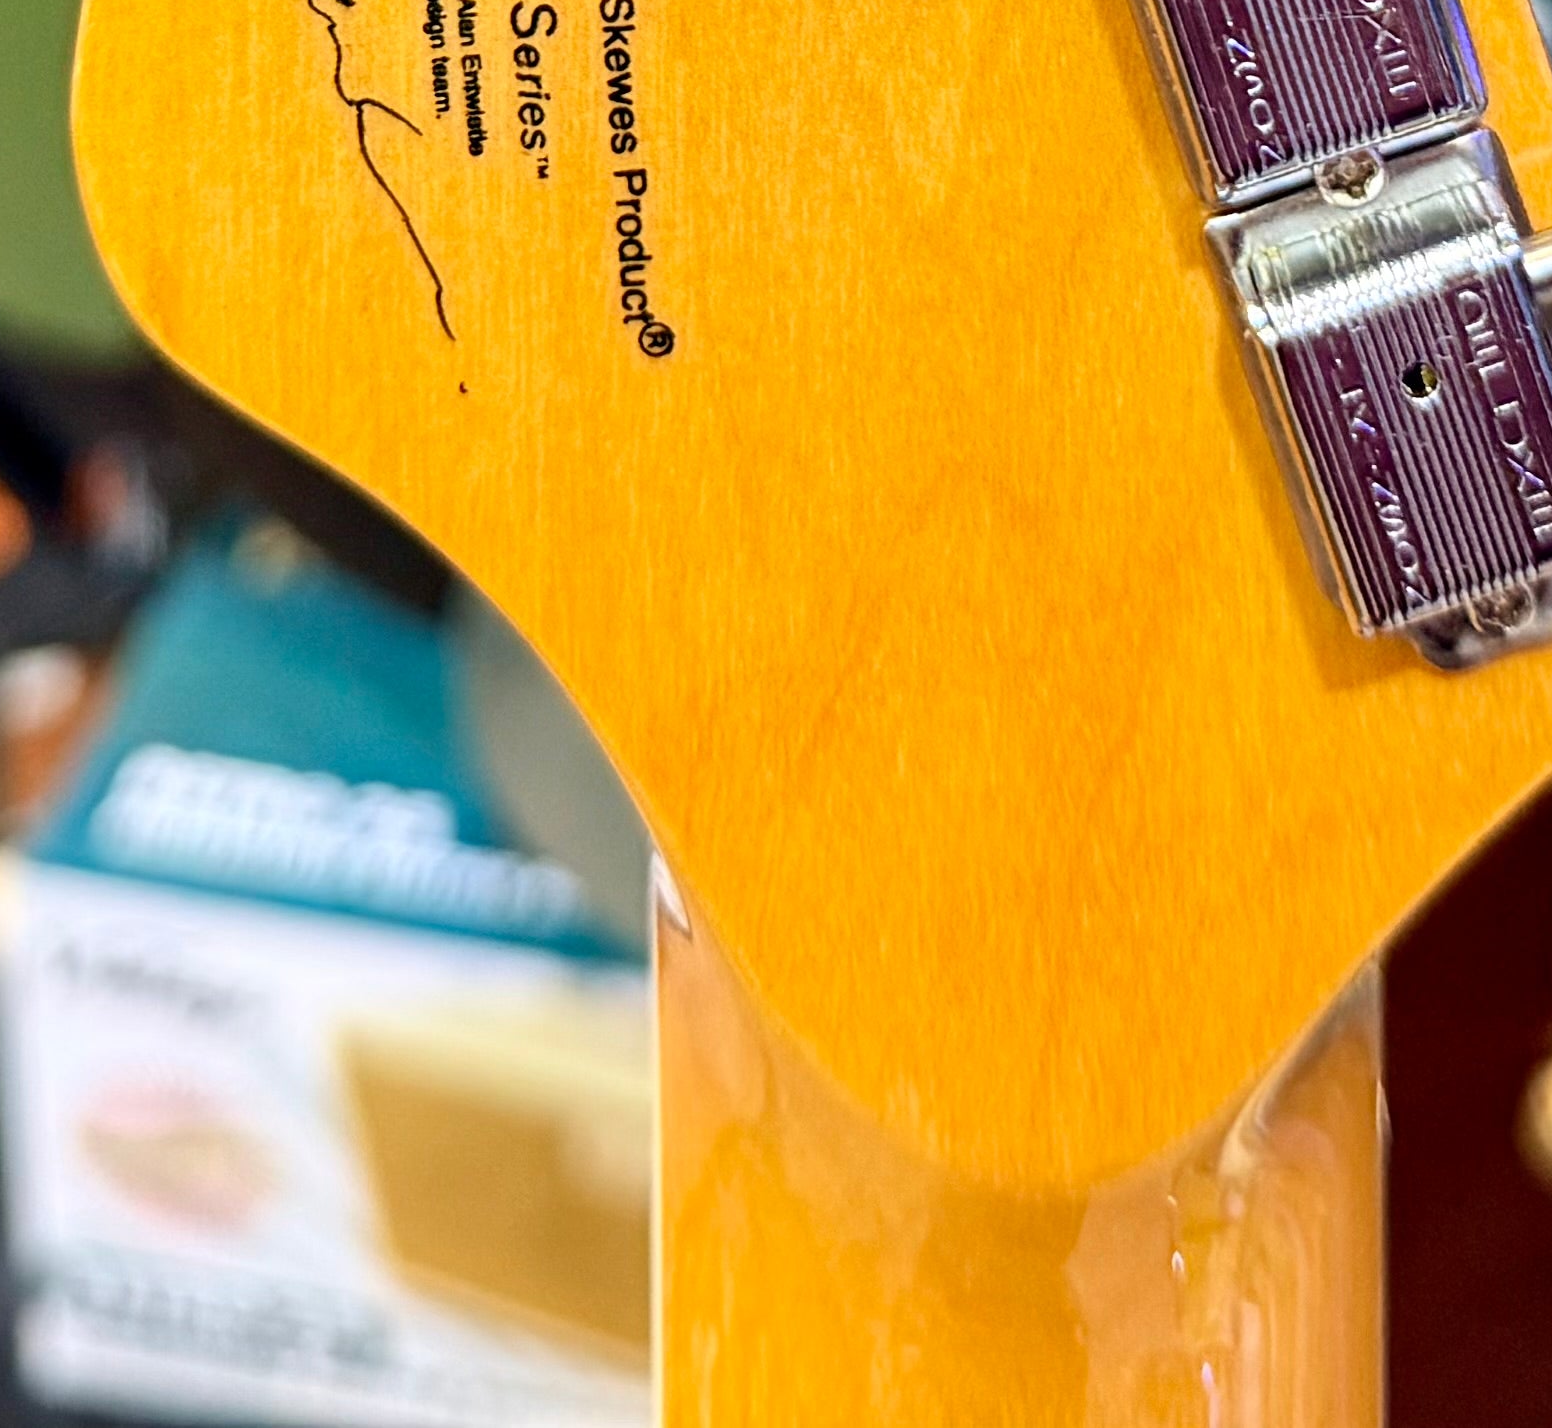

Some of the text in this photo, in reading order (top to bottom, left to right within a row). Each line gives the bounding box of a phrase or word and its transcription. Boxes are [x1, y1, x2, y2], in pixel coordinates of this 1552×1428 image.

[431, 55, 451, 119] team.
[460, 53, 488, 157] Entwistle
[1312, 297, 1428, 608] ILKINSON
